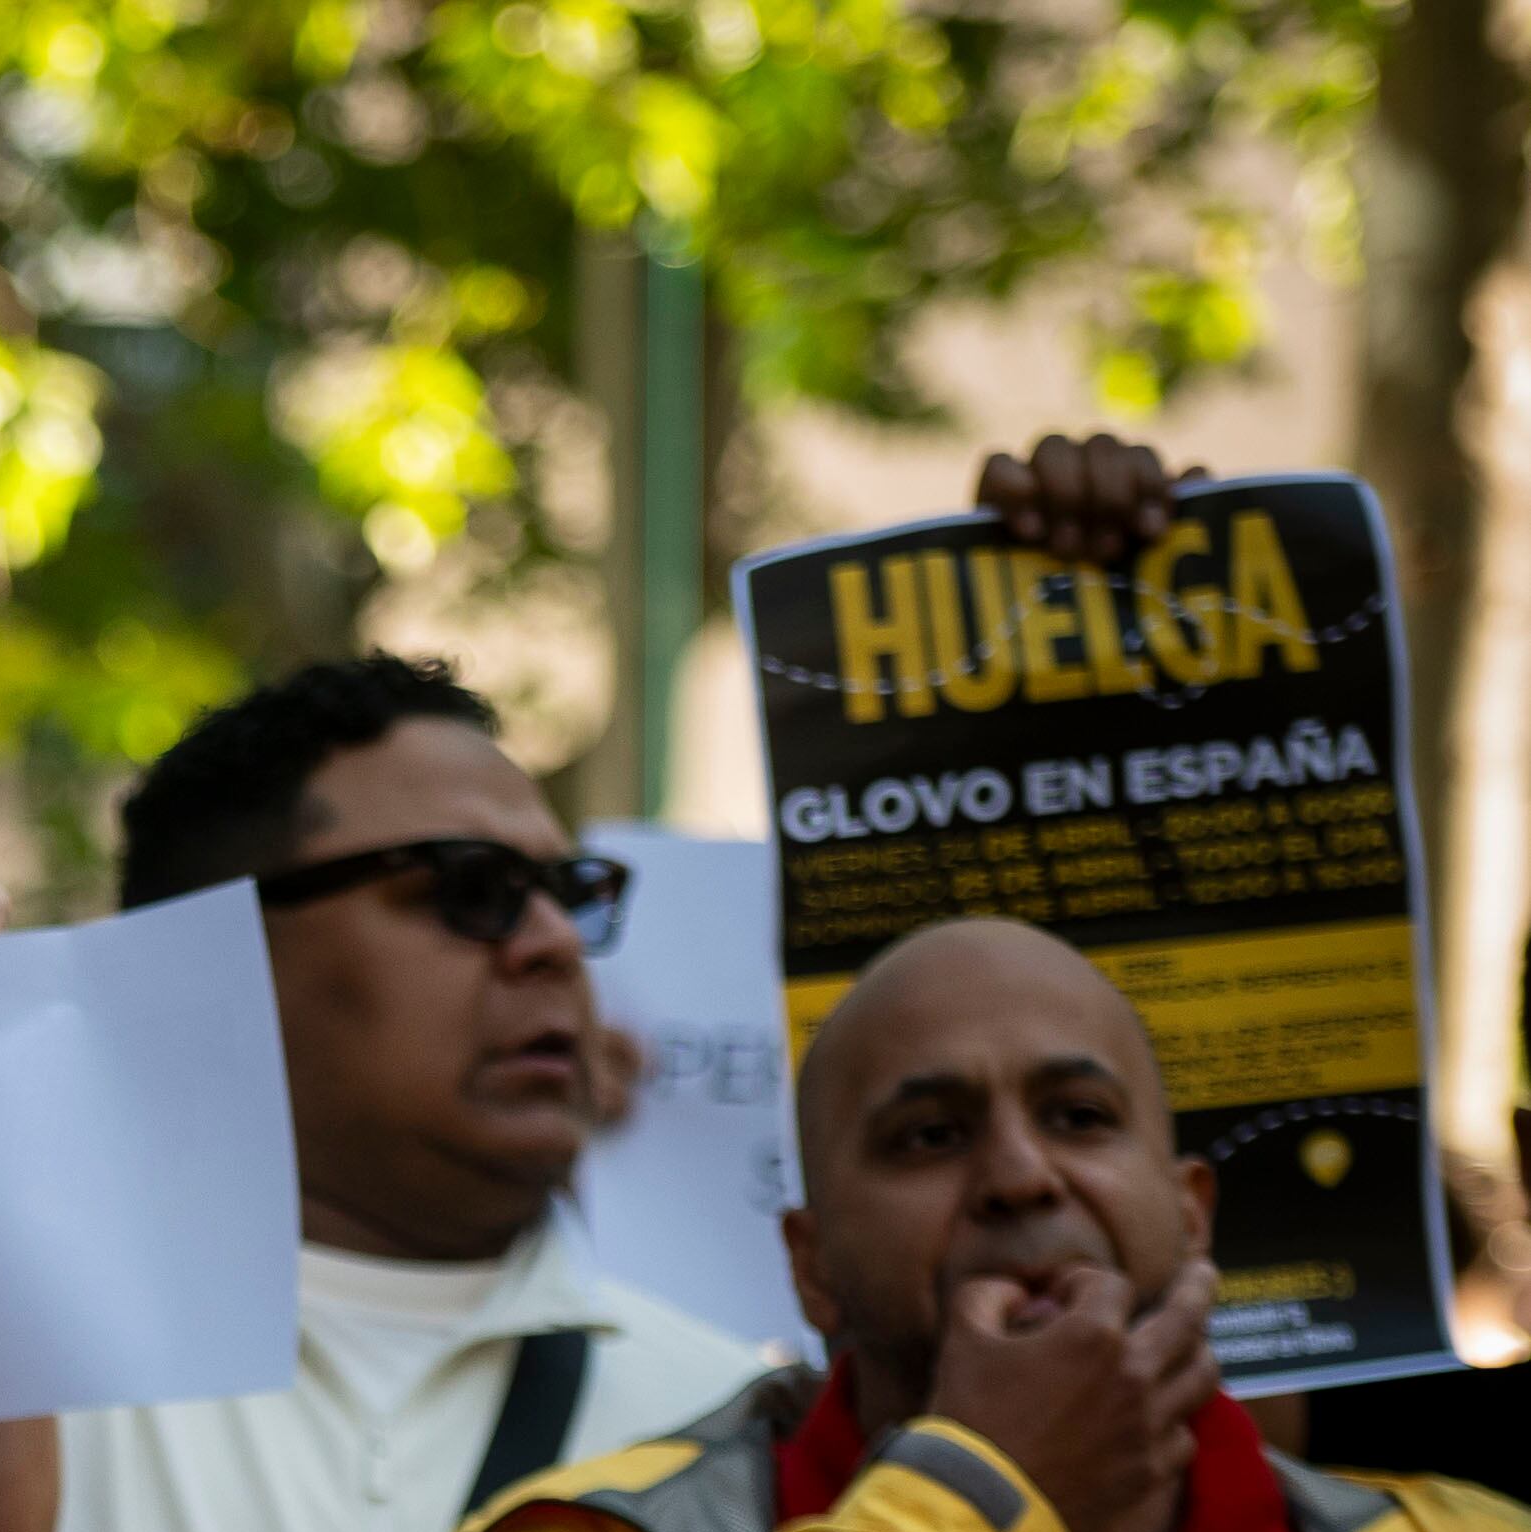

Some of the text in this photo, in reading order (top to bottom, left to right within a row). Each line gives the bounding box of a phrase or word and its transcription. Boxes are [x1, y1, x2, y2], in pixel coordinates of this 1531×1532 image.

[828, 508, 1320, 725] HUELGA
[779, 717, 1379, 844] GLOVO EN ESPAÑA
